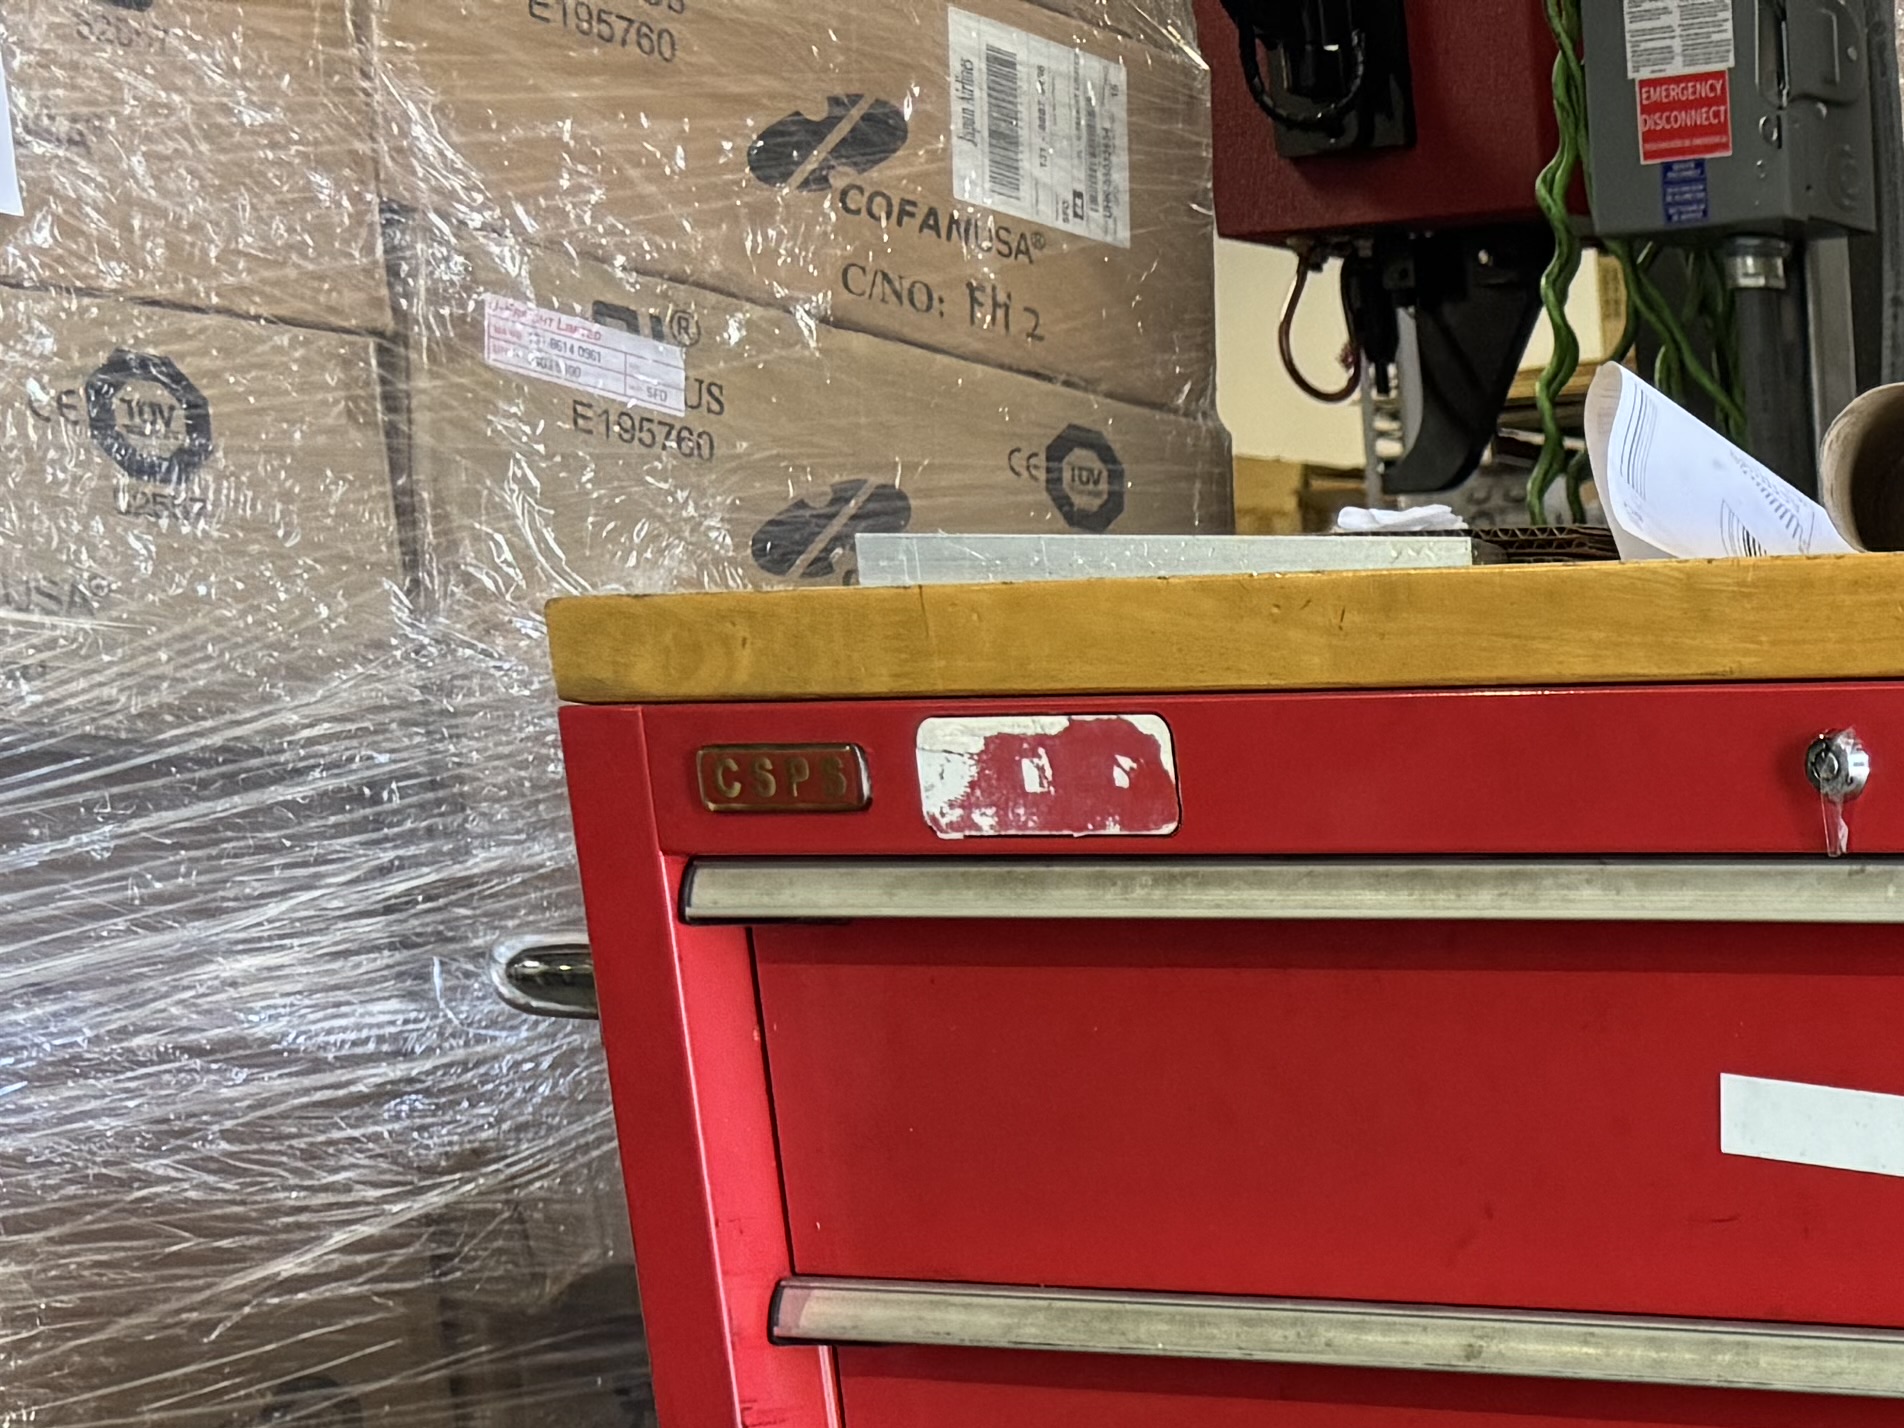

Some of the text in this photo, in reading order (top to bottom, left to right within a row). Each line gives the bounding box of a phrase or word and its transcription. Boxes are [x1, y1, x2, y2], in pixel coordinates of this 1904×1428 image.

[529, 0, 677, 62] E195760
[1641, 79, 1723, 105] EMERGENCY
[1641, 105, 1727, 132] DISCONNECT
[841, 262, 945, 319] C/NO:
[572, 399, 716, 463] E195760
[714, 756, 848, 799] CSPS
